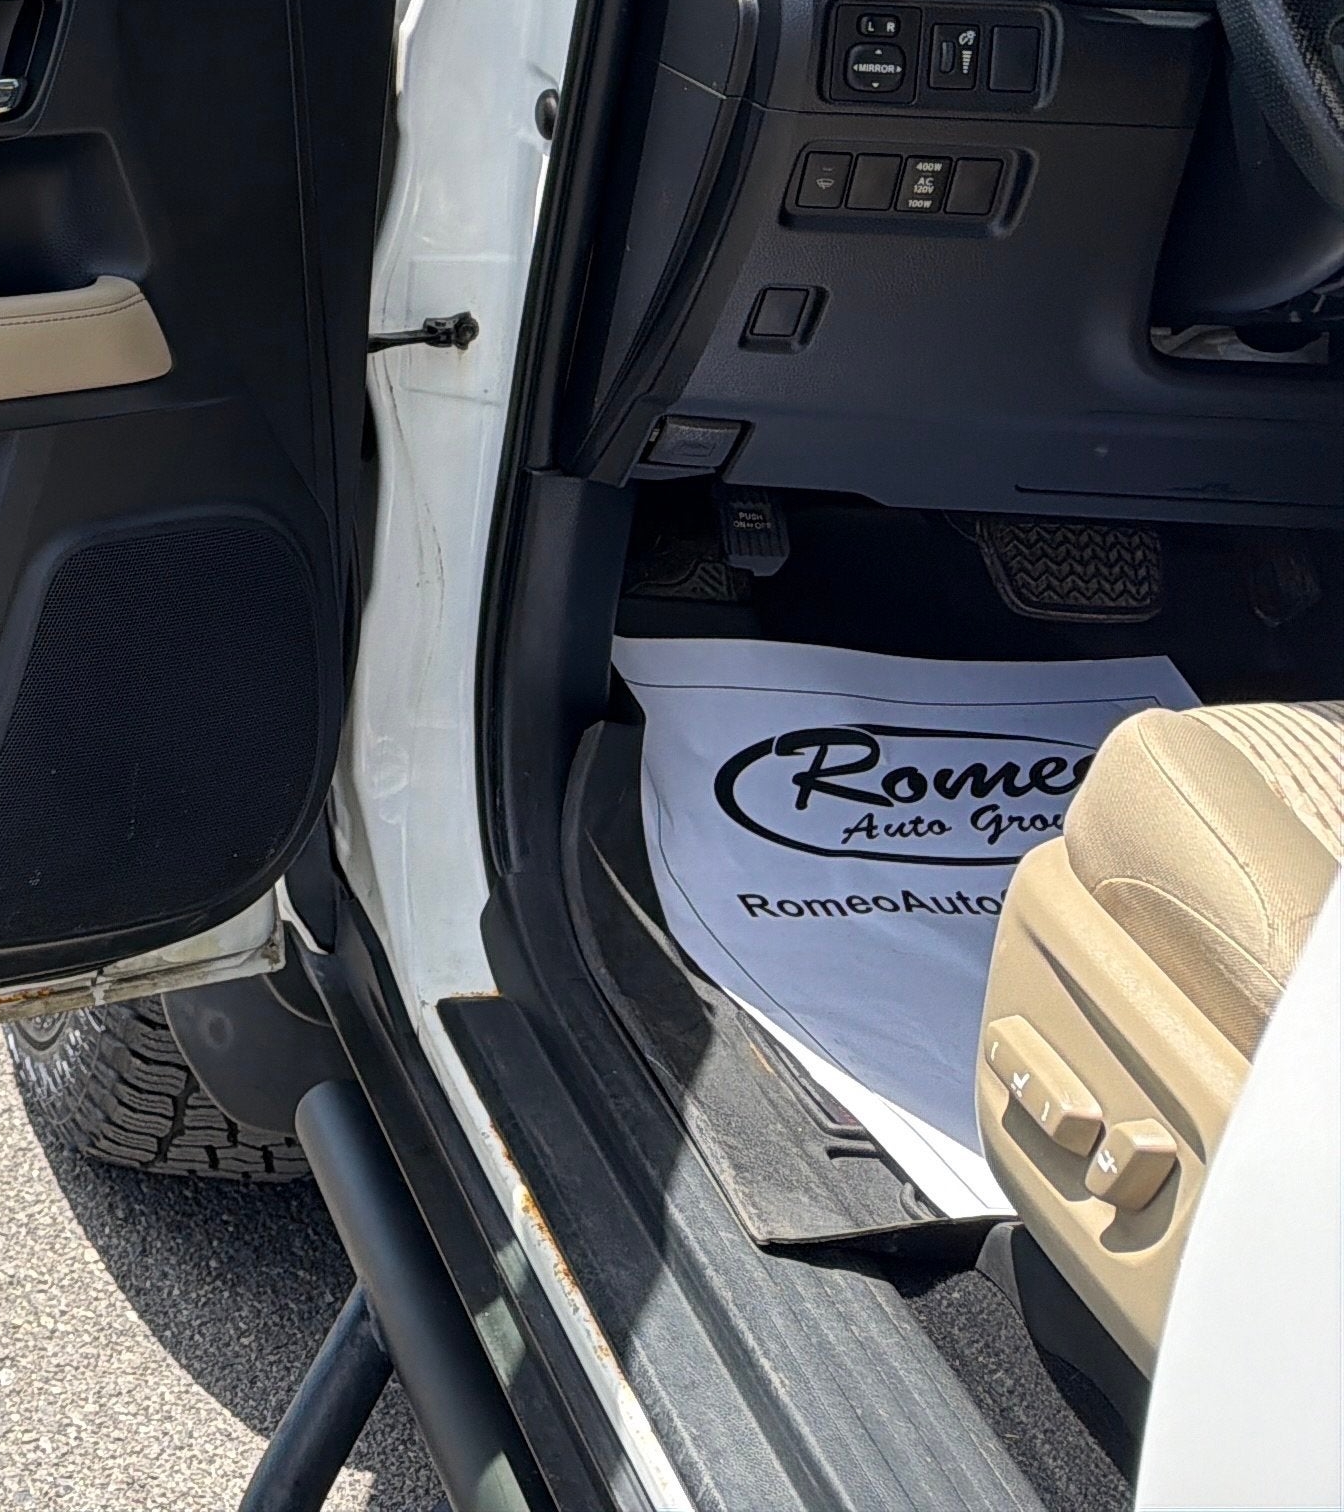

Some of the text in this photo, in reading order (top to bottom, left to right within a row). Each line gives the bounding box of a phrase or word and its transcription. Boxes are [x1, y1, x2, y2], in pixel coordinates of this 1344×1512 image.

[868, 21, 895, 33] L R
[858, 63, 895, 74] MIRROR
[915, 162, 942, 172] 400W
[917, 177, 934, 186] AC
[913, 185, 935, 194] 120V
[908, 199, 932, 209] 100W
[738, 511, 763, 520] PUSH
[841, 812, 952, 844] Auto
[737, 889, 1009, 919] RomeoAuto
